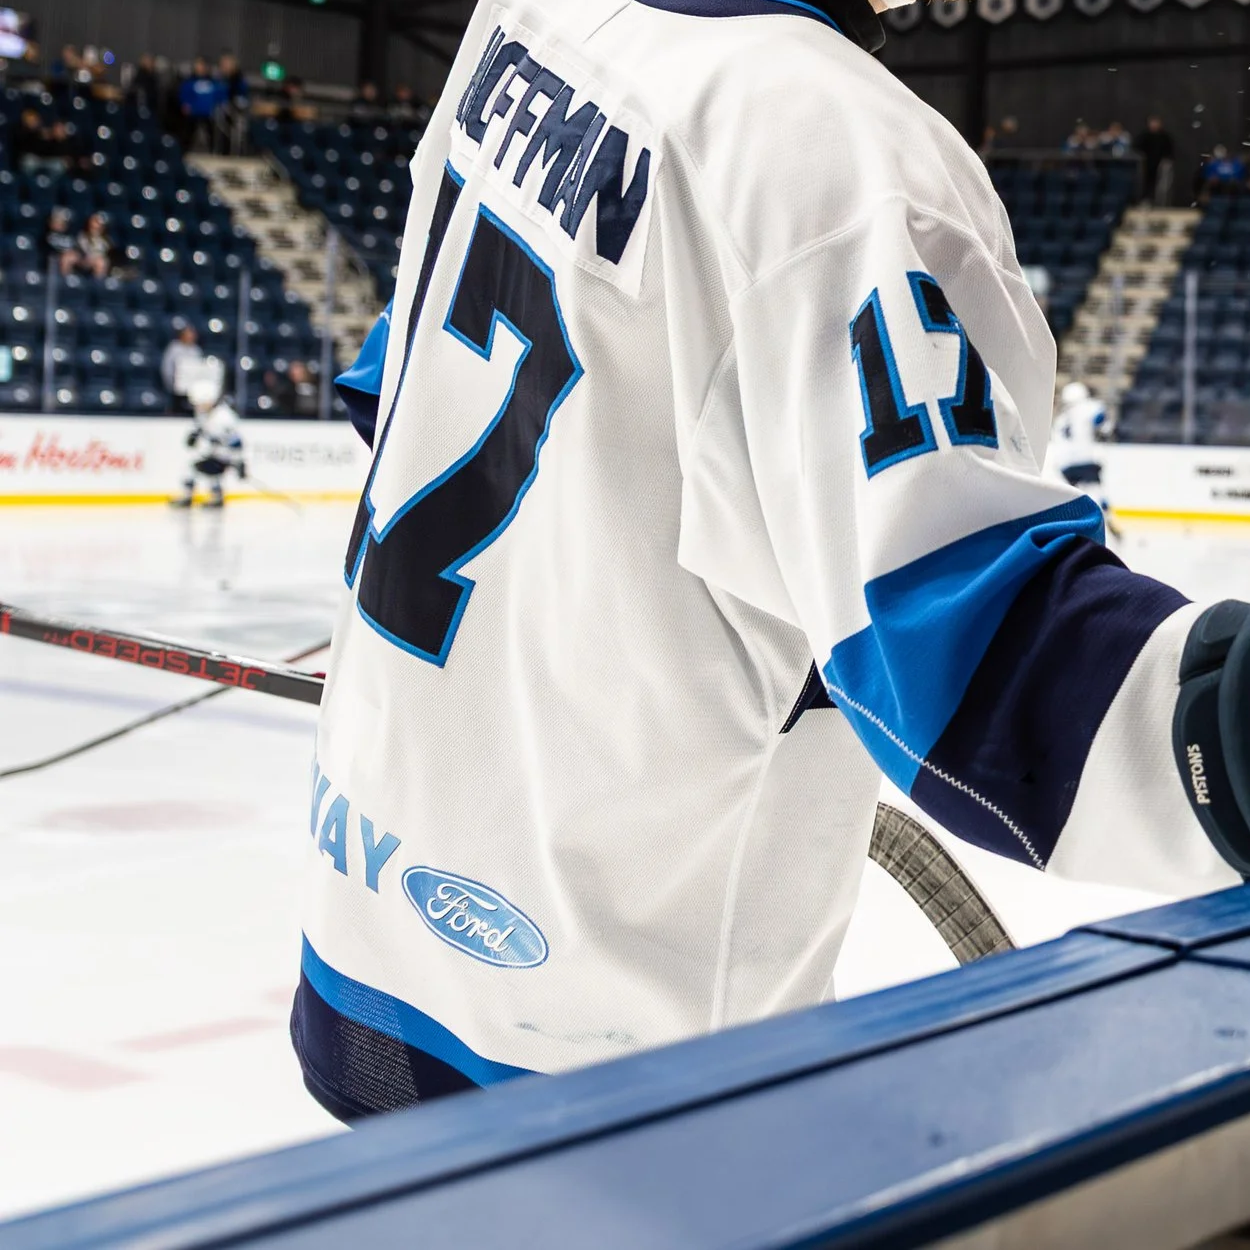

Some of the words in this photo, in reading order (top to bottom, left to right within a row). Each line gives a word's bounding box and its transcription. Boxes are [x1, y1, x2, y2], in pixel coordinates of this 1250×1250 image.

[849, 269, 1000, 480] 17
[69, 628, 267, 691] JETSPEED
[1187, 743, 1211, 805] PISTONS
[426, 882, 516, 954] Ford
